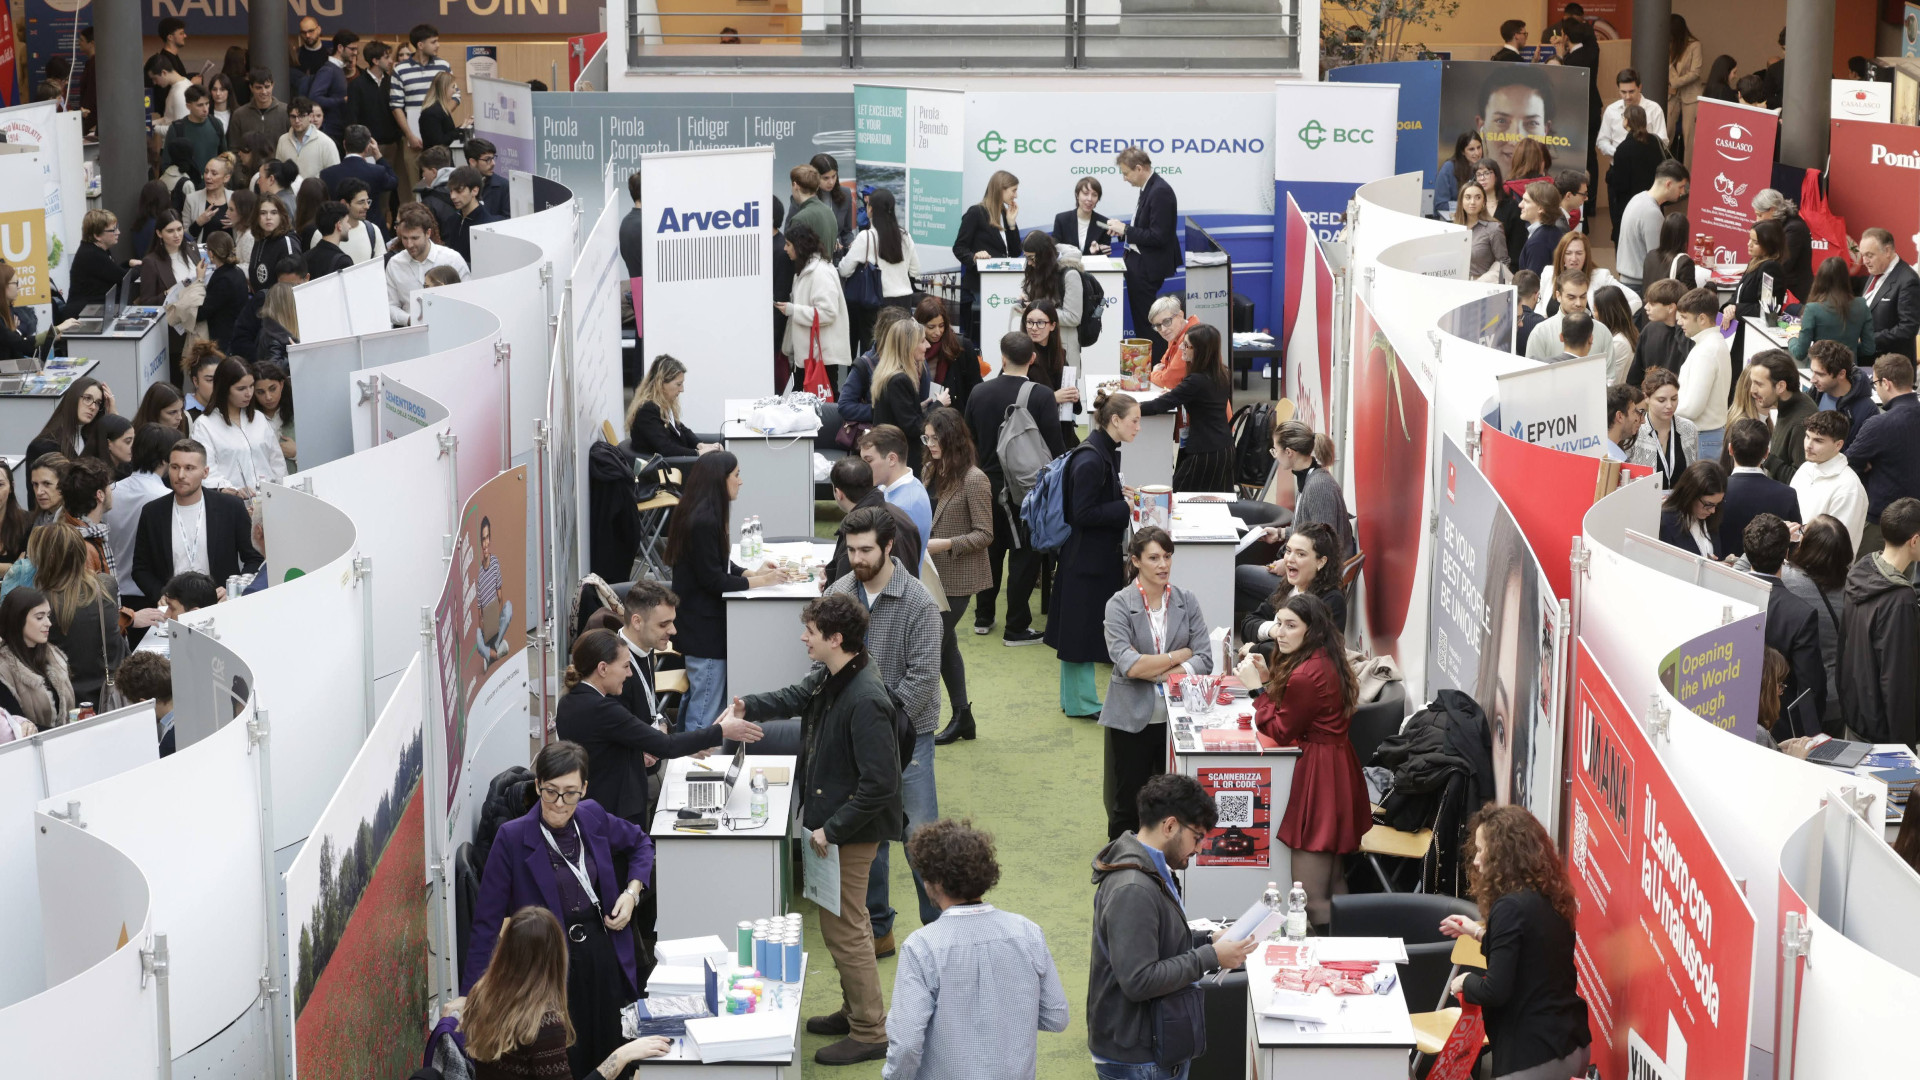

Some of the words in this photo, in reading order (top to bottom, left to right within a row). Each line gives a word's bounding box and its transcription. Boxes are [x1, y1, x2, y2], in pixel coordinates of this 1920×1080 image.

[857, 104, 867, 115] LET
[869, 105, 903, 118] EXCELLENCE
[919, 106, 940, 120] Pirola
[1841, 101, 1881, 109] CASALASCO
[543, 116, 578, 137] Pirola
[610, 116, 644, 137] Pirola
[688, 116, 730, 140] Fidiger
[754, 116, 796, 140] Fidiger
[858, 119, 865, 129] BE
[866, 119, 881, 130] YOUR
[919, 120, 948, 136] Pennuto
[1396, 120, 1423, 131] OGIA
[858, 133, 892, 145] INSPIRATION
[918, 135, 929, 148] Zei
[1333, 128, 1374, 144] BCC
[1486, 132, 1525, 143] SIAMO
[1715, 138, 1753, 153] CASALASCO
[543, 139, 594, 160] Pennuto
[1013, 138, 1057, 155] BCC
[1070, 138, 1165, 155] CREDITO
[1171, 138, 1265, 155] PADANO
[1070, 167, 1116, 175] GRUPPO
[656, 201, 760, 234] Arvedi
[1527, 414, 1577, 443] EPYON
[1444, 515, 1454, 550] BE
[1454, 526, 1476, 578] YOUR
[1442, 548, 1461, 591] BEST
[1440, 581, 1451, 615] BE
[1681, 641, 1734, 675] Opening
[1681, 679, 1698, 700] the
[1702, 659, 1741, 691] World
[1690, 692, 1726, 719] rough
[1712, 713, 1736, 730] tion
[1208, 773, 1261, 781] SCANNERIZZA
[1581, 700, 1628, 836] UMANA
[1222, 781, 1233, 789] QR
[1651, 797, 1689, 904] Lavoro
[1688, 877, 1713, 949] con
[1641, 841, 1652, 902] la
[1652, 860, 1663, 915] U
[1660, 901, 1720, 1029] maiuscola
